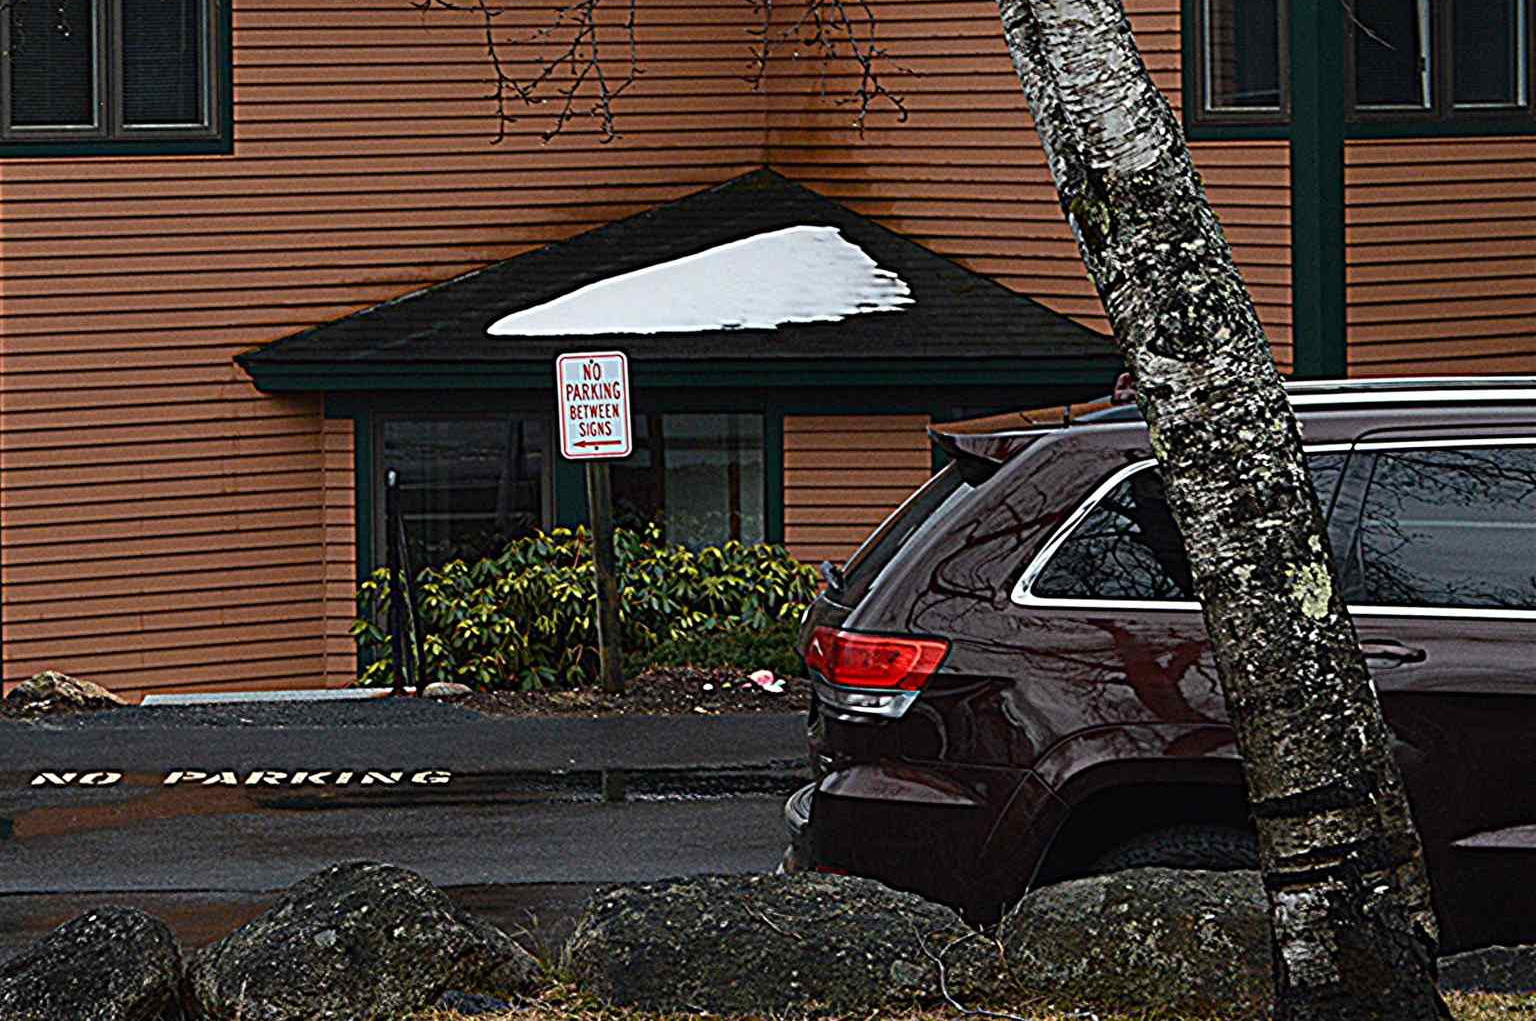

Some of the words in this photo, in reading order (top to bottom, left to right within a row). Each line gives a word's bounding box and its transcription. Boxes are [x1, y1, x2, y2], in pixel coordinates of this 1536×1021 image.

[583, 363, 601, 381] NO
[566, 381, 621, 401] PARKING
[569, 403, 620, 420] BETWEEN
[579, 421, 612, 437] SIGNS
[31, 772, 122, 786] NO
[163, 770, 452, 786] PARKING
